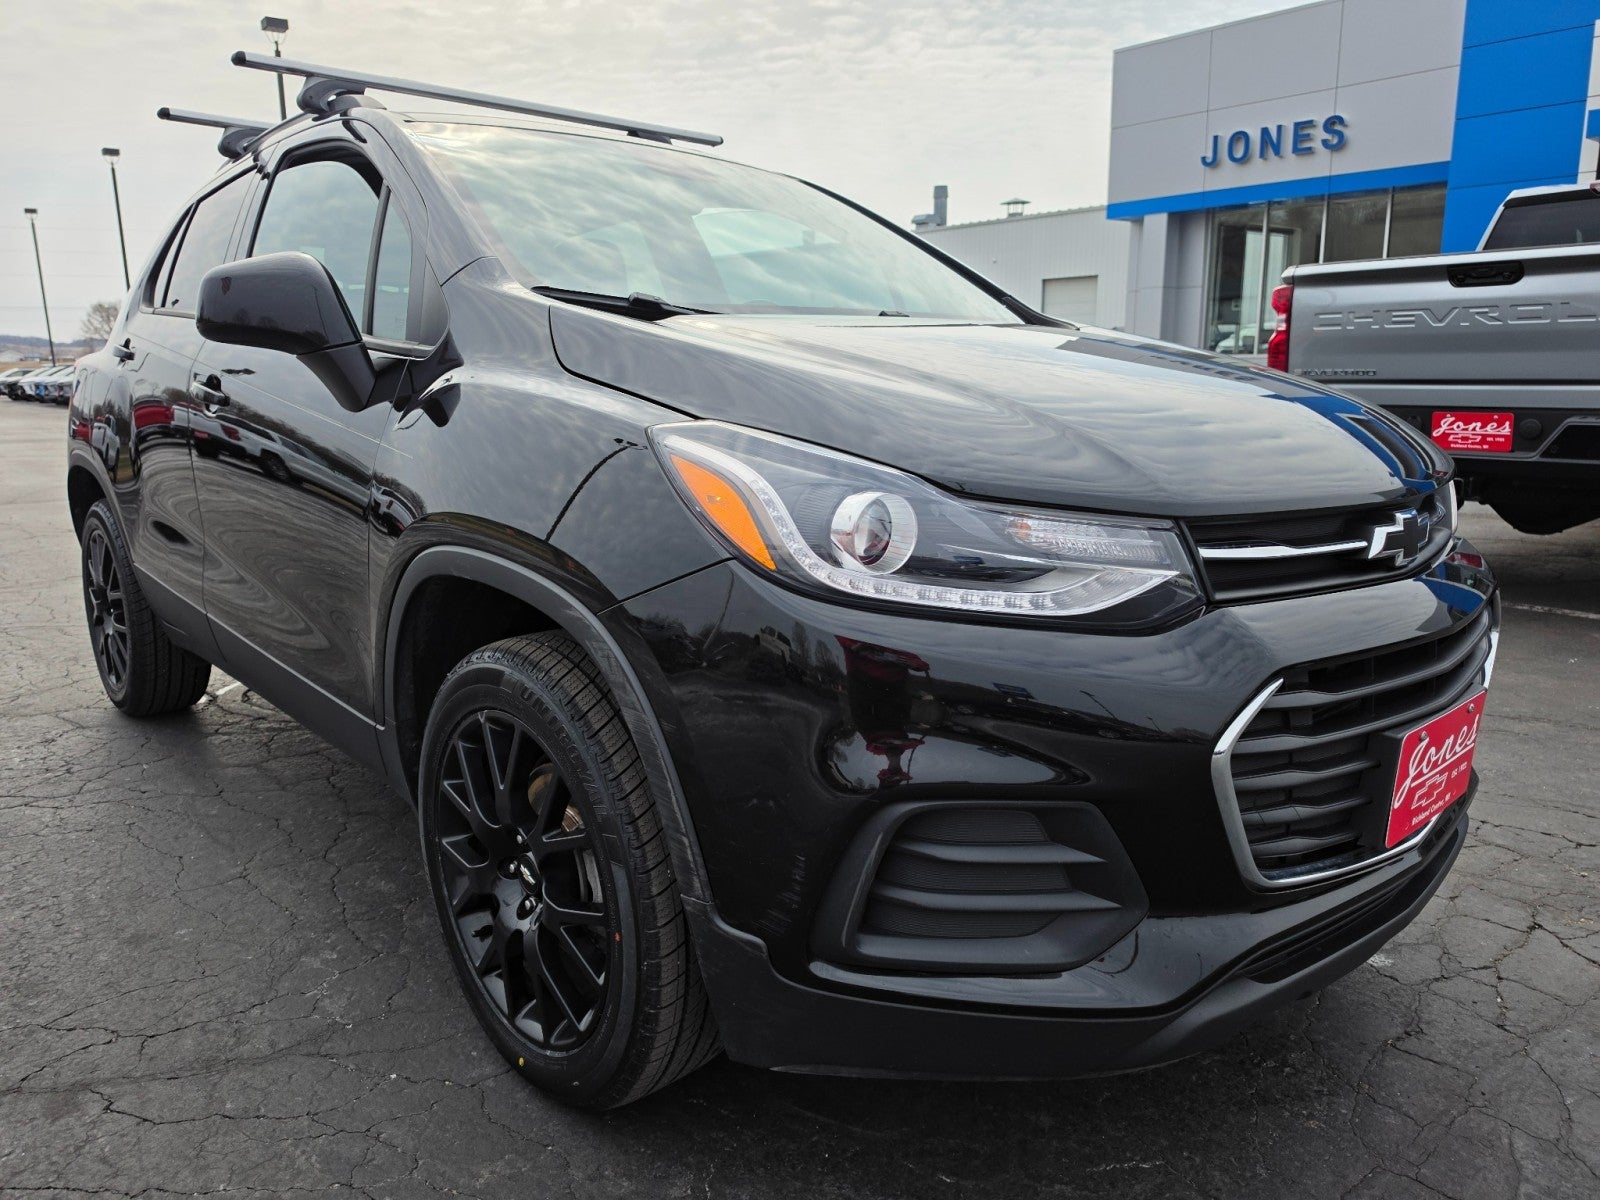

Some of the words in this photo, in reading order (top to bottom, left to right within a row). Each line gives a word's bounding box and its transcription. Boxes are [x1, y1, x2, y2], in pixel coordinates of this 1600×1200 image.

[1201, 115, 1347, 167] JONES
[1313, 302, 1600, 330] CHEVROL
[1433, 416, 1511, 437] Jones
[1394, 714, 1480, 809] Jones
